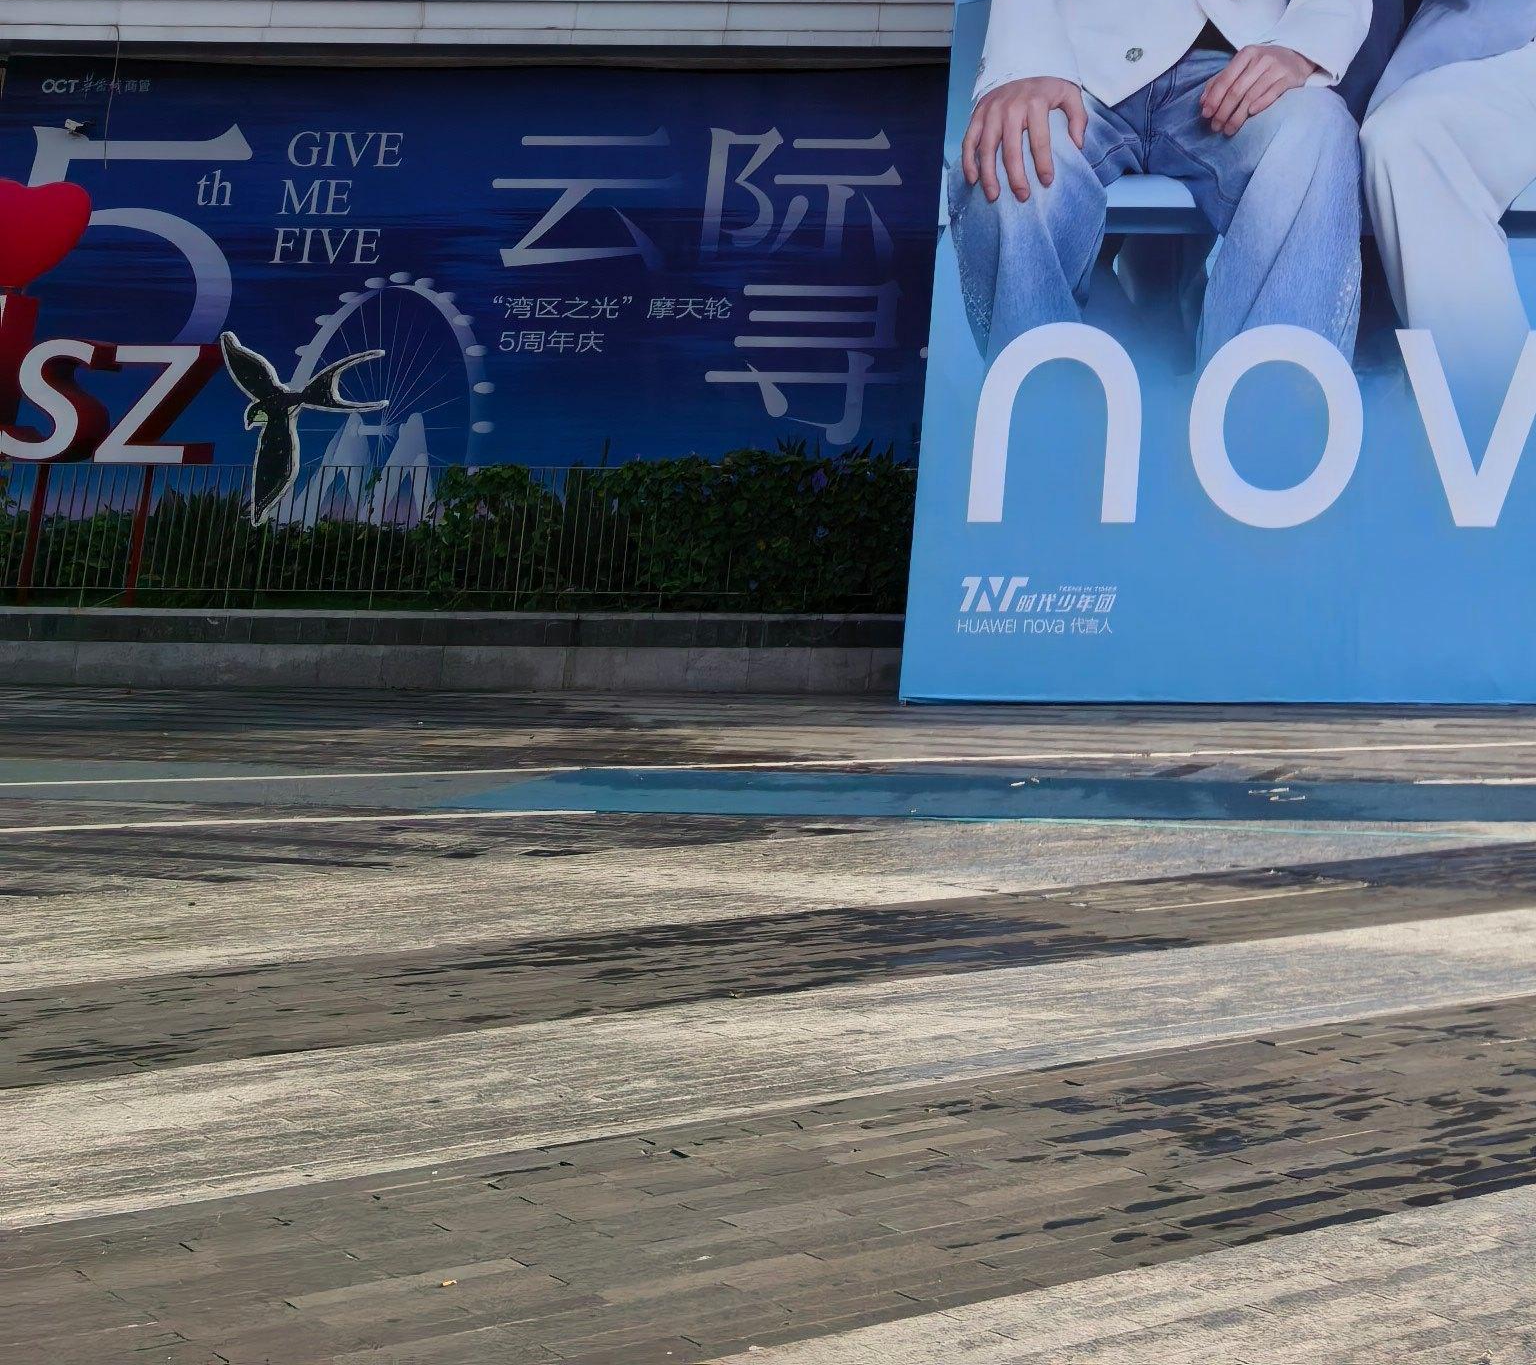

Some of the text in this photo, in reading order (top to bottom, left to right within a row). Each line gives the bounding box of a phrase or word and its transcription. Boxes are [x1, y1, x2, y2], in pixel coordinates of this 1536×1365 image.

[41, 78, 79, 94] OCT
[288, 131, 404, 168] GIVE
[277, 179, 353, 215] ME
[492, 125, 903, 271] 云际
[268, 227, 382, 264] FIVE
[646, 296, 733, 319] 摩天轮
[498, 330, 605, 353] 5周年庆
[1015, 593, 1117, 613] 时代少年团
[957, 617, 1113, 634] HUAWEI nova 代言人
